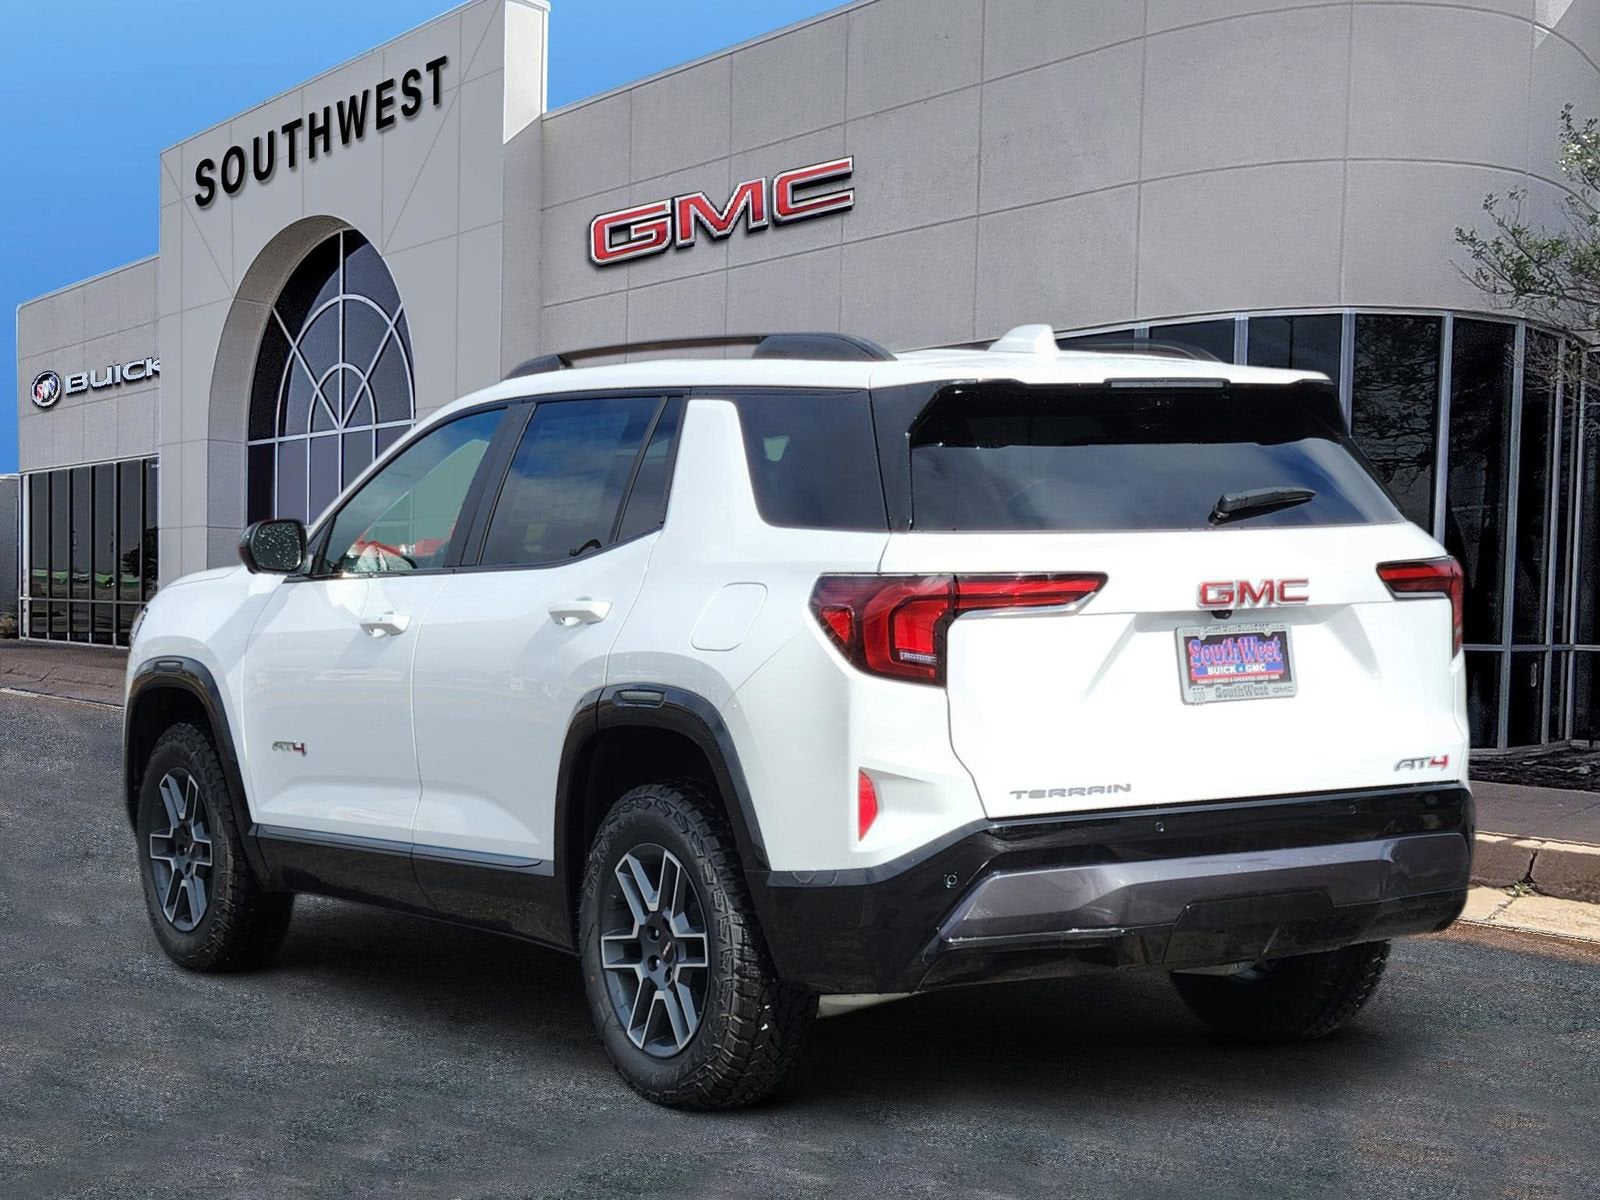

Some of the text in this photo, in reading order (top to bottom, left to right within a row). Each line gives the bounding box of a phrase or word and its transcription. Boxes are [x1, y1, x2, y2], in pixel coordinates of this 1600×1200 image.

[194, 55, 448, 208] SOUTHWEST
[588, 155, 855, 266] GMC
[65, 357, 160, 395] BUICK
[1197, 578, 1309, 609] GMC
[1208, 663, 1267, 675] BUICK GMC
[1393, 754, 1449, 772] AT4
[1009, 783, 1131, 799] TERRAIN
